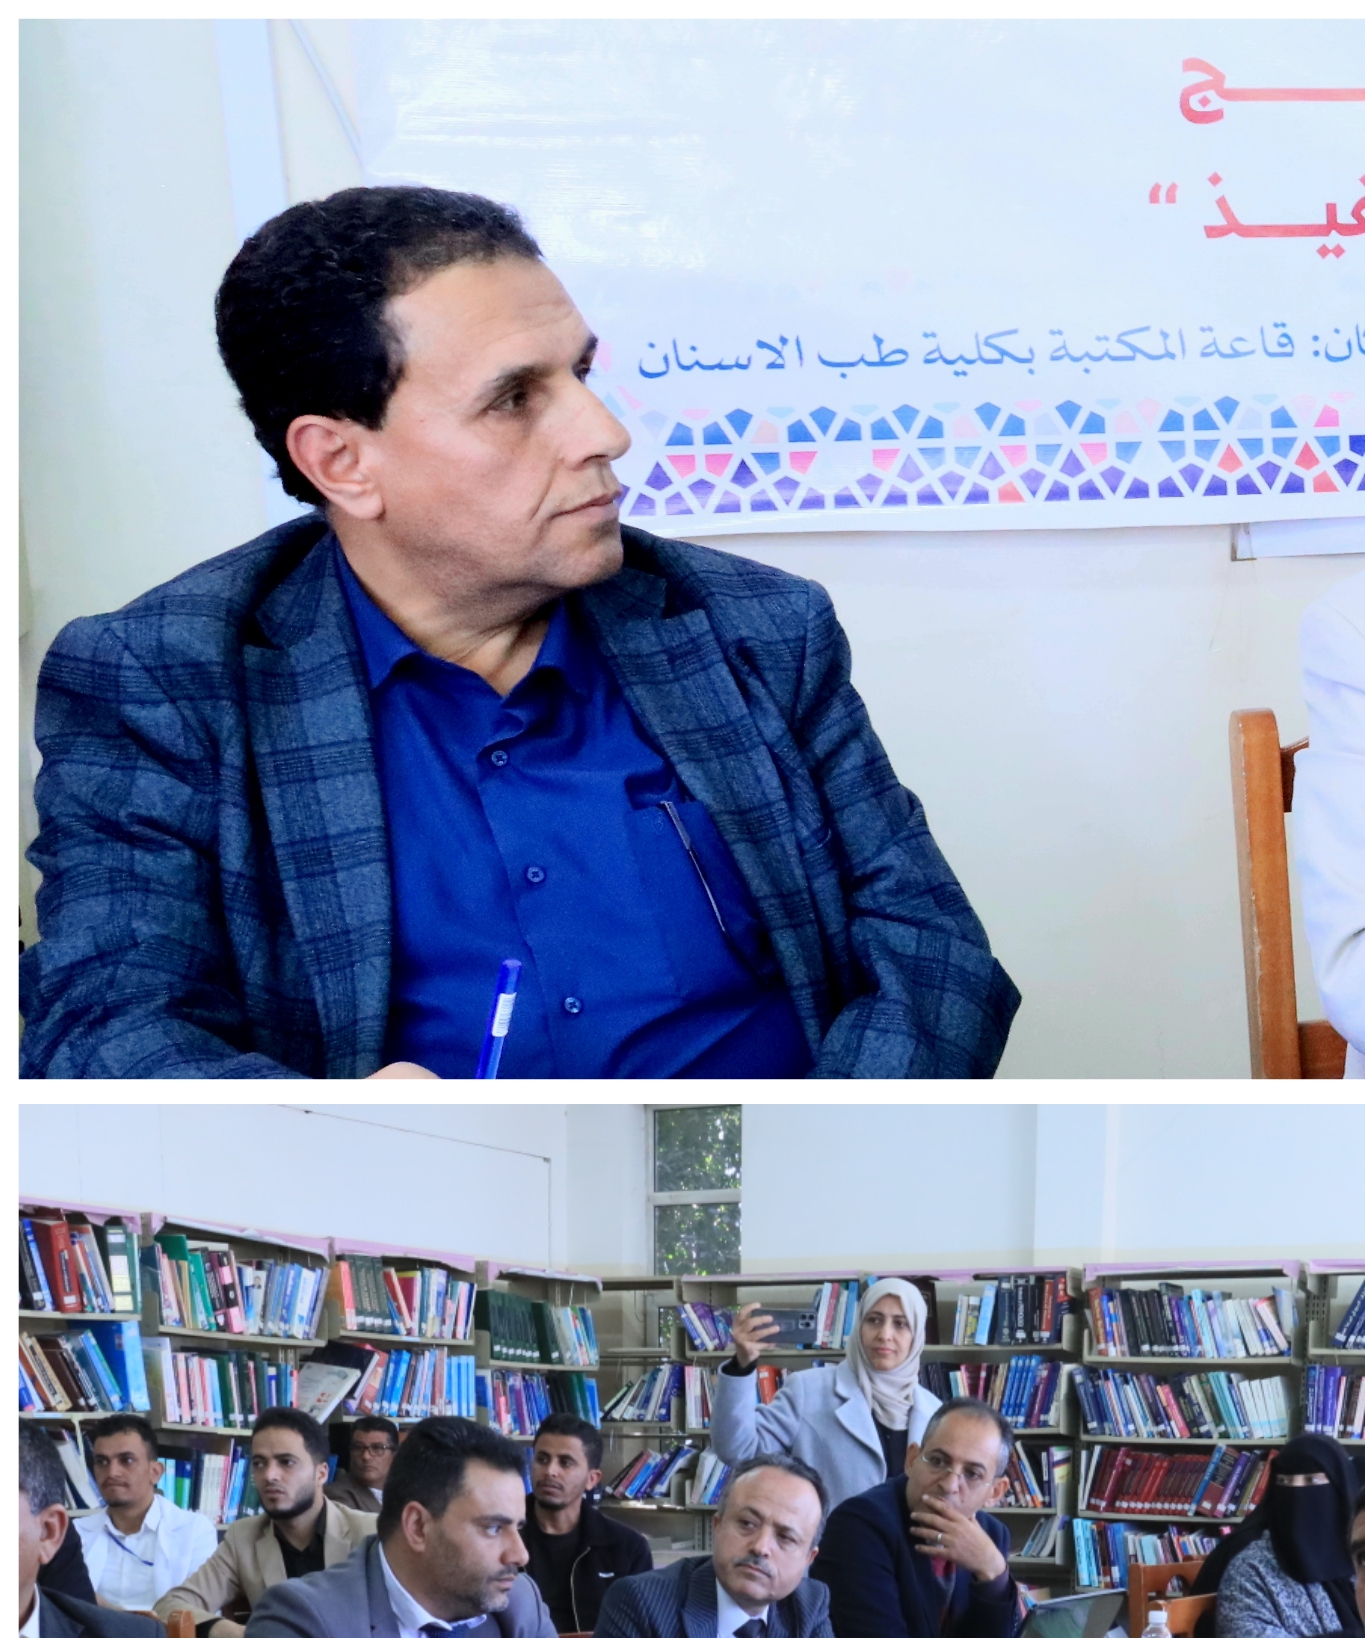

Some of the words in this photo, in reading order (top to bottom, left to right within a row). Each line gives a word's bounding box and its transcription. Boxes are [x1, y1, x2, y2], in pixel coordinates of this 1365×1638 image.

[638, 336, 804, 380] الاسنان
[816, 334, 910, 380] طب
[922, 329, 1038, 380] بكلية
[1049, 328, 1187, 366] المكتبة
[1199, 323, 1296, 361] قاعة
